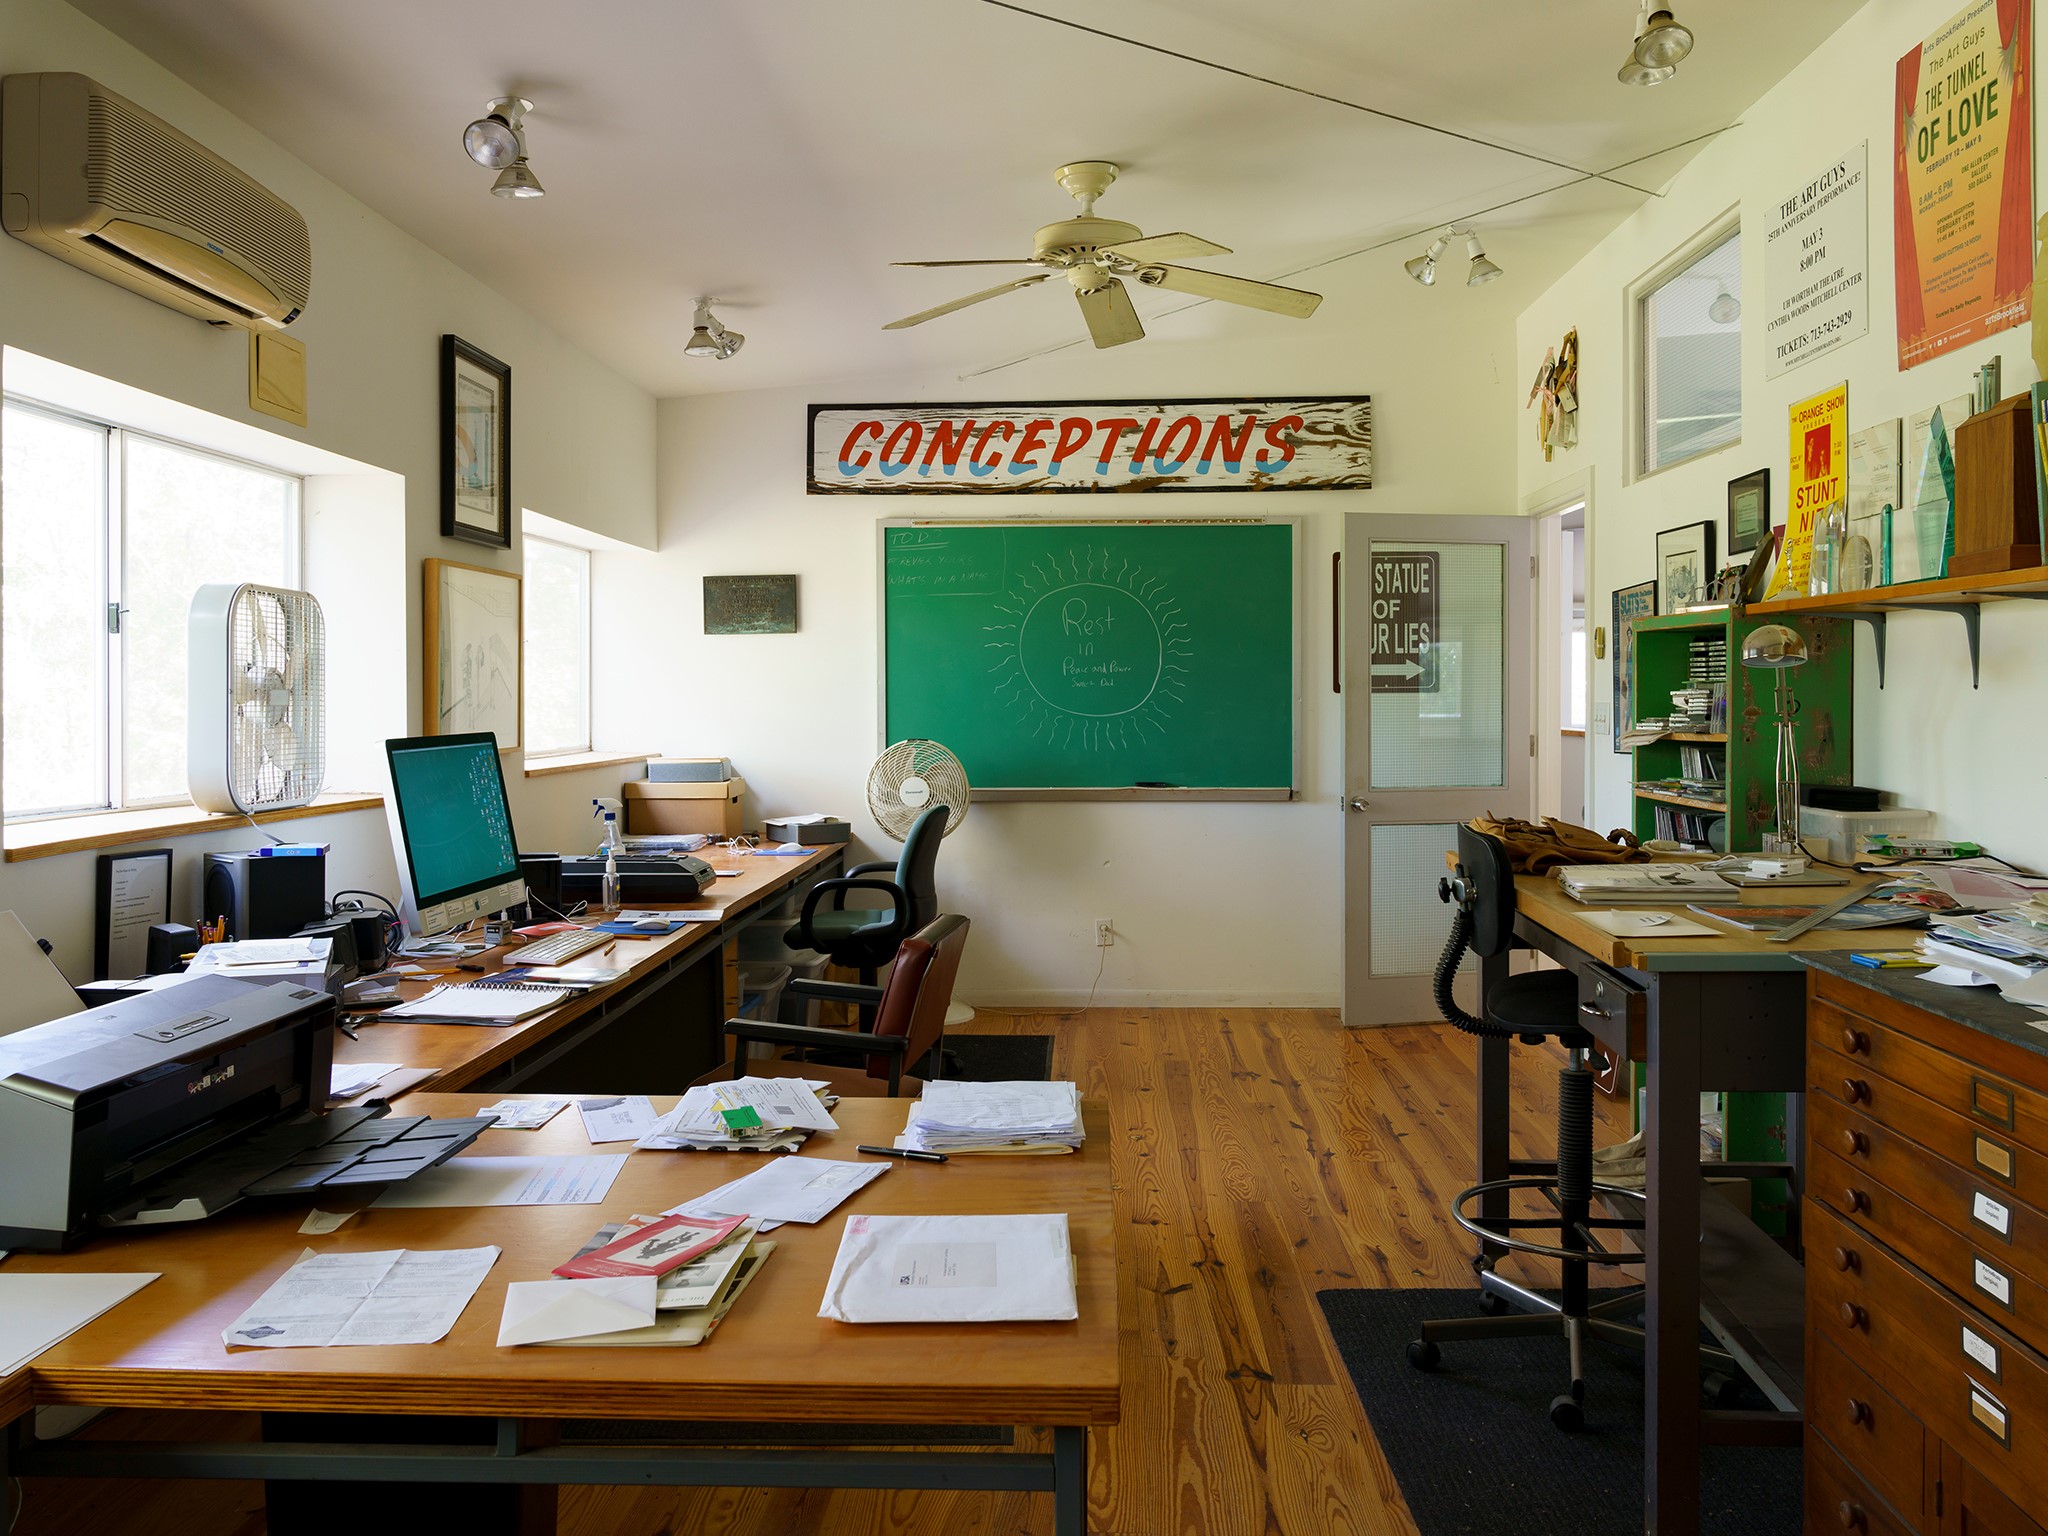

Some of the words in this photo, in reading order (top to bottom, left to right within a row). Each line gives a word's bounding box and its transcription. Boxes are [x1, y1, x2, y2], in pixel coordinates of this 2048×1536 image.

[1923, 43, 1934, 56] Arts
[1935, 18, 1966, 46] Brookfield
[1967, 0, 1994, 22] Presents
[1929, 58, 1944, 75] The
[1946, 43, 1959, 63] Art
[1962, 26, 1985, 50] Guys
[1925, 81, 1943, 115] THE
[1947, 51, 1987, 100] TUNNEL
[1917, 116, 1940, 164] OF
[1947, 78, 1998, 146] LOVE
[1925, 153, 1953, 175] FEBRUARY
[1953, 147, 1960, 157] 12
[1965, 139, 1977, 151] MAY
[1978, 134, 1982, 143] 9
[1970, 156, 1982, 170] ALLEN
[1982, 147, 1999, 162] CENTER
[1970, 163, 1989, 178] GALLERY
[1780, 196, 1799, 221] THE
[1800, 181, 1819, 208] ART
[1820, 161, 1846, 193] GUYS
[1923, 190, 1933, 203] AM
[1943, 178, 1953, 192] PM
[1976, 172, 1992, 187] DALLAS
[1768, 227, 1781, 243] 25TH
[1780, 203, 1817, 236] ANNIVERSARY
[1816, 171, 1861, 211] PERFORMANCE!
[1802, 230, 1819, 252] MAY
[1819, 227, 1824, 241] 3
[1936, 216, 1961, 235] FEBRUARY
[1799, 253, 1814, 273] 8:00
[1814, 246, 1826, 264] PM
[1767, 314, 1791, 332] CYNTHIA
[1790, 302, 1810, 320] WOODS
[1810, 286, 1839, 310] MITCHELL
[1838, 272, 1863, 293] CENTER
[1782, 299, 1791, 311] UH
[1791, 282, 1819, 305] WORTHAM
[1819, 266, 1845, 290] THEATRE
[1984, 303, 2025, 326] artsBrookfield
[1776, 333, 1810, 359] TICKETS:
[1810, 309, 1853, 342] 713-743-2929
[1798, 403, 1824, 423] ORANGE
[1826, 394, 1845, 412] SHOW
[1803, 413, 1834, 431] PRESENTS
[838, 415, 1305, 478] CONCEPTIONS
[1796, 477, 1839, 509] STUNT
[889, 531, 914, 545] TO
[1374, 562, 1430, 594] STATUE
[1062, 597, 1116, 636] Rest
[1372, 599, 1401, 620] OF
[1394, 622, 1430, 654] LIES
[1062, 656, 1089, 676] Peace
[1091, 662, 1107, 674] and
[1109, 660, 1132, 673] Power
